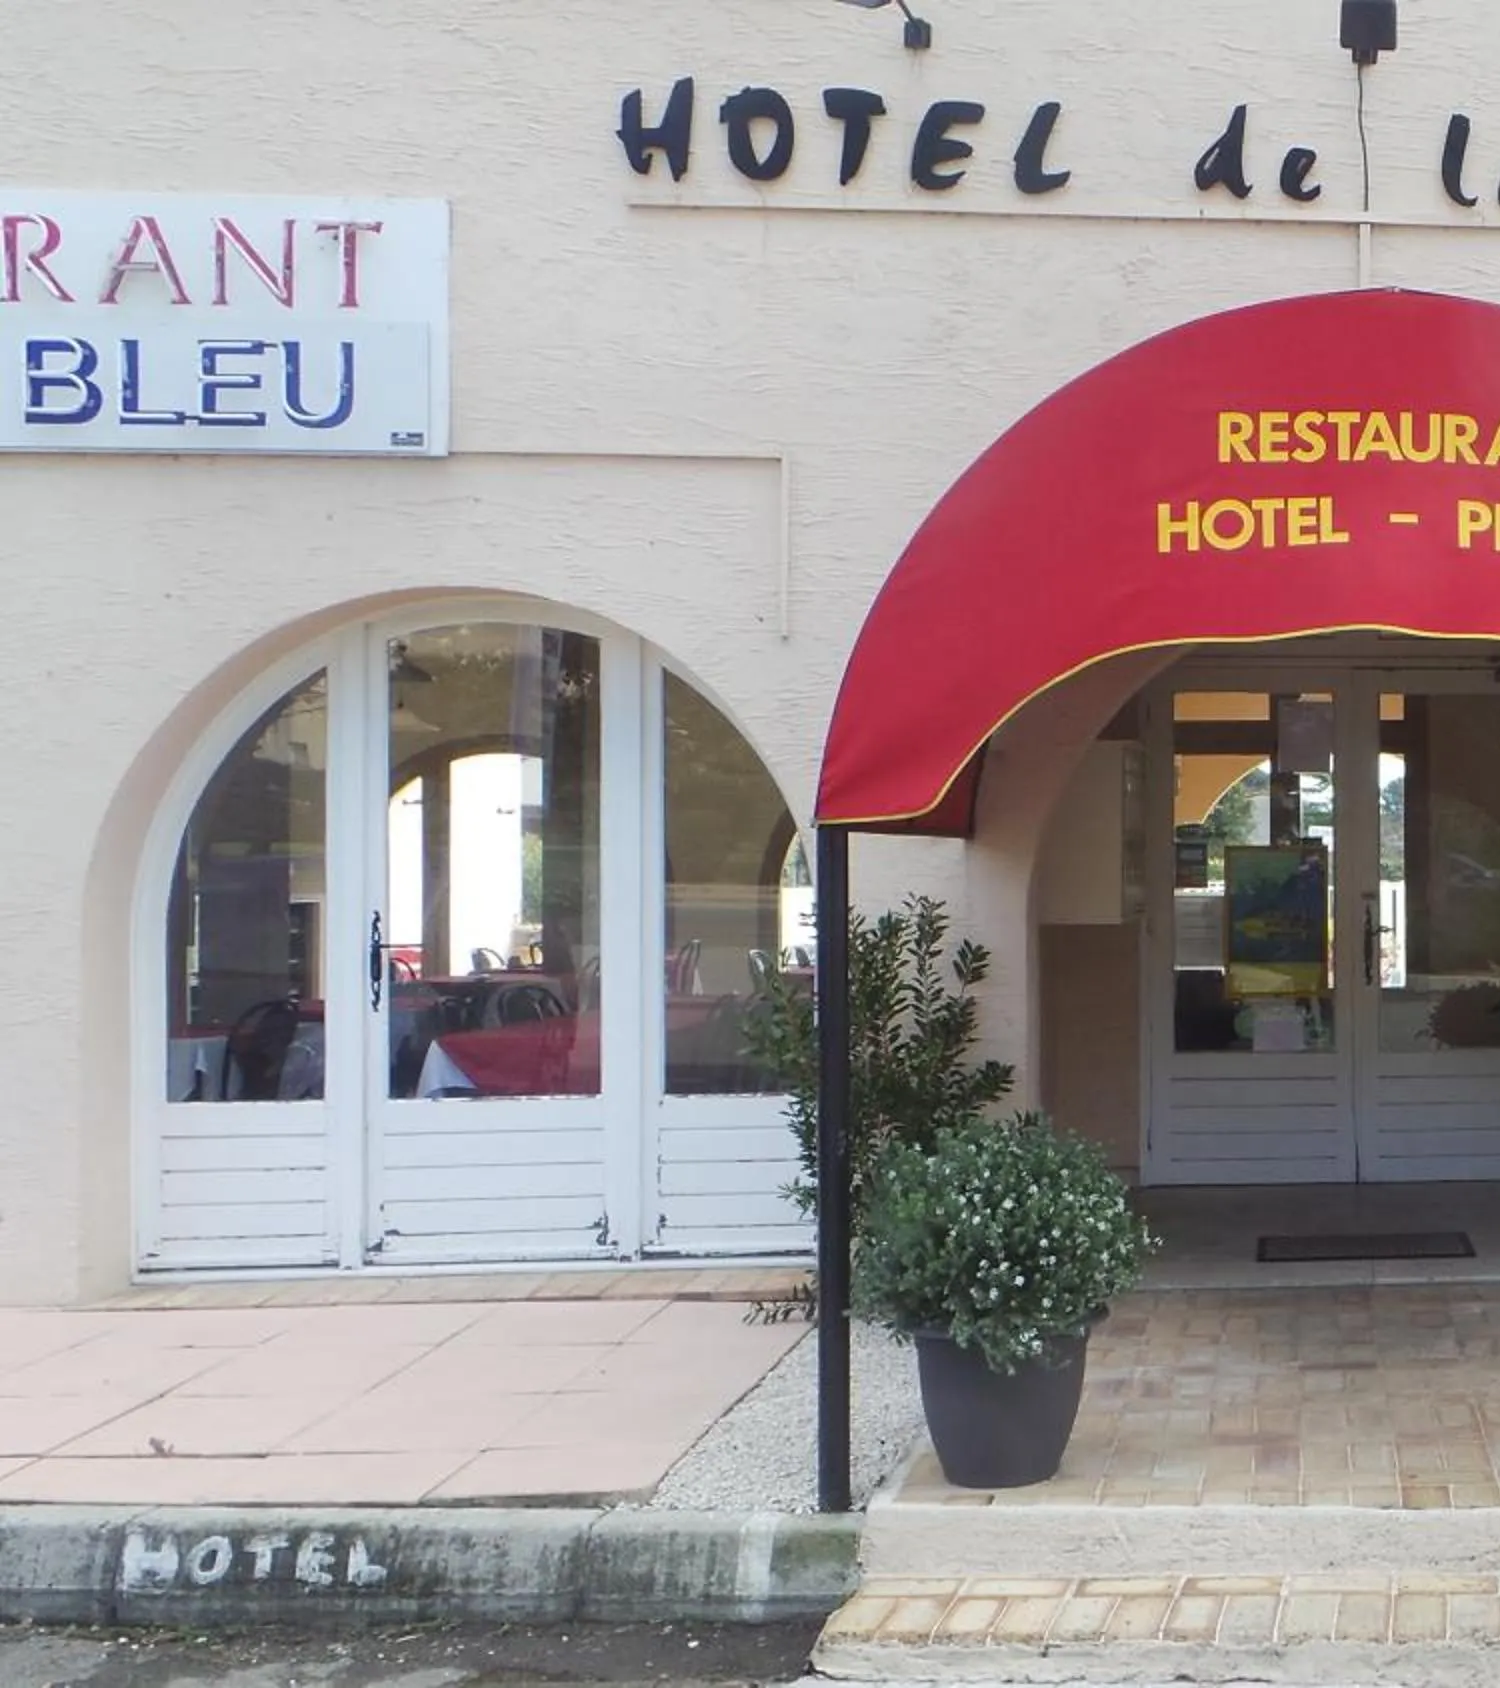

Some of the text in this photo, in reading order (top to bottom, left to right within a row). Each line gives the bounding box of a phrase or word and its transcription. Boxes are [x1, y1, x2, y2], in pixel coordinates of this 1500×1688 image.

[615, 76, 1070, 194] HOTEL
[1195, 104, 1322, 201] de
[0, 212, 383, 308] RANT
[25, 335, 355, 429] BLEU
[1157, 496, 1349, 553] HOTEL
[120, 1532, 387, 1594] HOTEL
